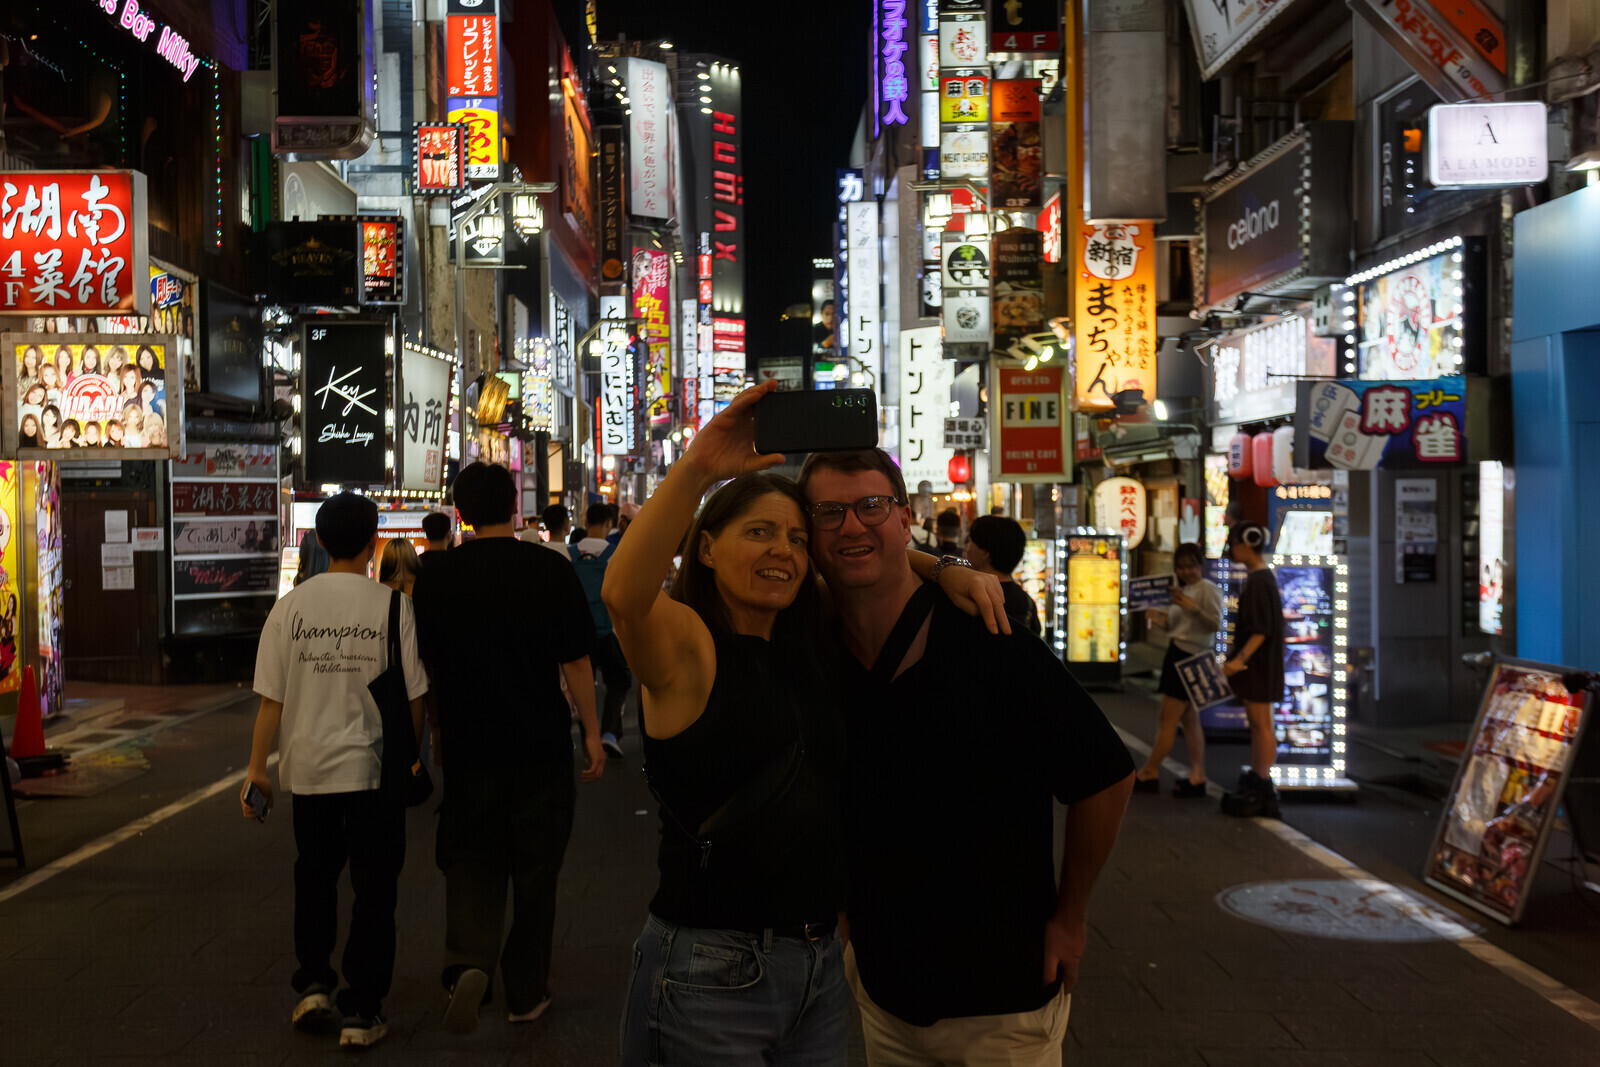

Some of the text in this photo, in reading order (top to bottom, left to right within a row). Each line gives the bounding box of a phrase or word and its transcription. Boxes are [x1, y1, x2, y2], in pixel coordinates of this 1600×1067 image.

[121, 0, 155, 42] Bar
[156, 26, 199, 82] Milky
[463, 18, 480, 95] リフレッシュ
[946, 80, 984, 97] 麻雀
[1458, 159, 1478, 170] LA
[1486, 157, 1538, 168] MODE
[713, 111, 743, 262] HUMAX
[1, 174, 126, 246] 湖南
[1227, 200, 1280, 250] celona
[1088, 240, 1134, 266] 新宿
[1104, 265, 1119, 278] の
[311, 329, 327, 341] 3F
[1087, 283, 1121, 398] まっちゃん
[314, 365, 378, 417] Key
[908, 338, 923, 462] トントン
[1006, 401, 1056, 420] FINE
[1414, 390, 1460, 409] フリー
[292, 611, 386, 650] Champion
